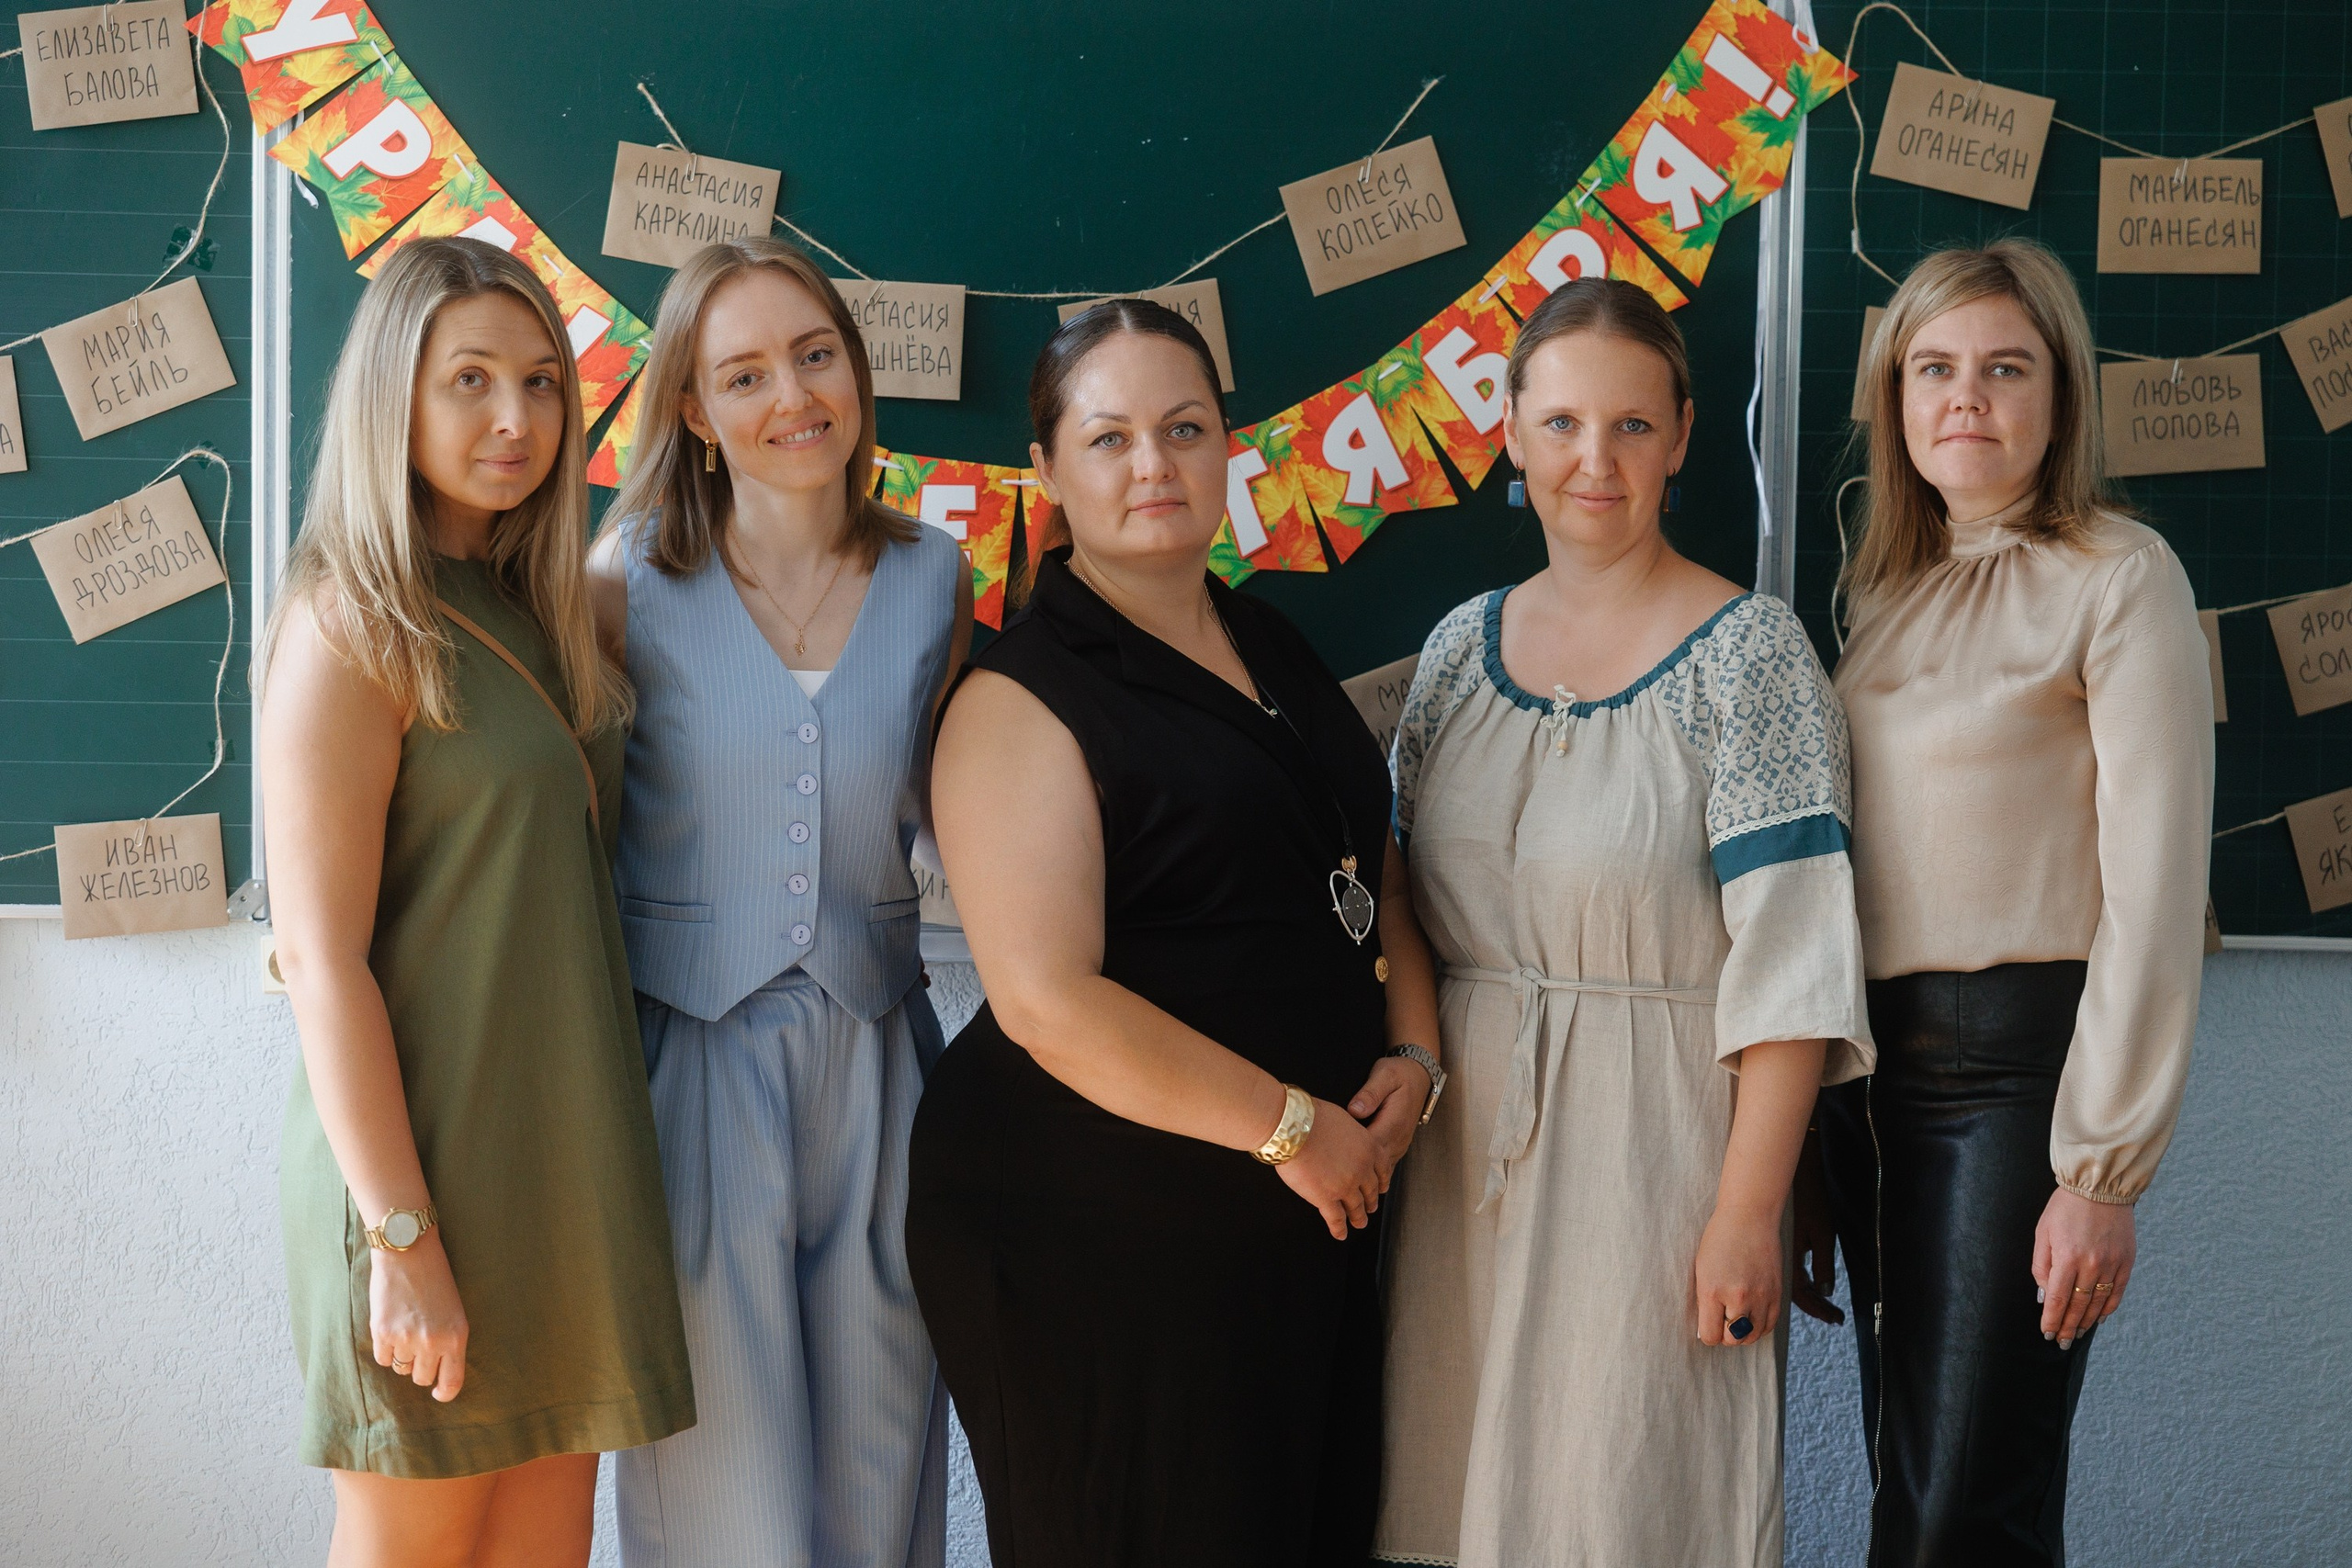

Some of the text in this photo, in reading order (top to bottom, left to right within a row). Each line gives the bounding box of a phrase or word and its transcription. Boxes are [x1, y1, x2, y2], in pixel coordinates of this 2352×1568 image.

[37, 17, 170, 62] ЕЛИЗАВЕТА
[63, 63, 159, 107] БАЛОВА
[1928, 88, 2016, 136] АРИНА
[1897, 122, 2029, 180] ОГАНЕСЯН
[636, 161, 763, 209] АНАСТАСИЯ
[1326, 163, 1413, 216] ОЛЕСЯ
[2128, 173, 2261, 207] МАРИБЕЛЬ
[1316, 192, 1444, 262] КОПЕЙКО
[2119, 217, 2257, 249] ОГАНЕСЯН
[843, 297, 949, 333] АСТАСИЯ
[83, 311, 171, 371] МАРИЯ
[869, 333, 953, 378] ШНЁВА
[91, 355, 189, 415] БЕЙЛЬ
[2132, 374, 2243, 409] ЛЮБОВЬ
[2132, 410, 2241, 444] ПОПОВА
[74, 504, 162, 565] ОЛЕСЯ
[72, 530, 207, 612] ДРОЗДОВА
[105, 833, 178, 867] ИВАН
[79, 862, 211, 904] ЖЕЛЕЗНОВ
